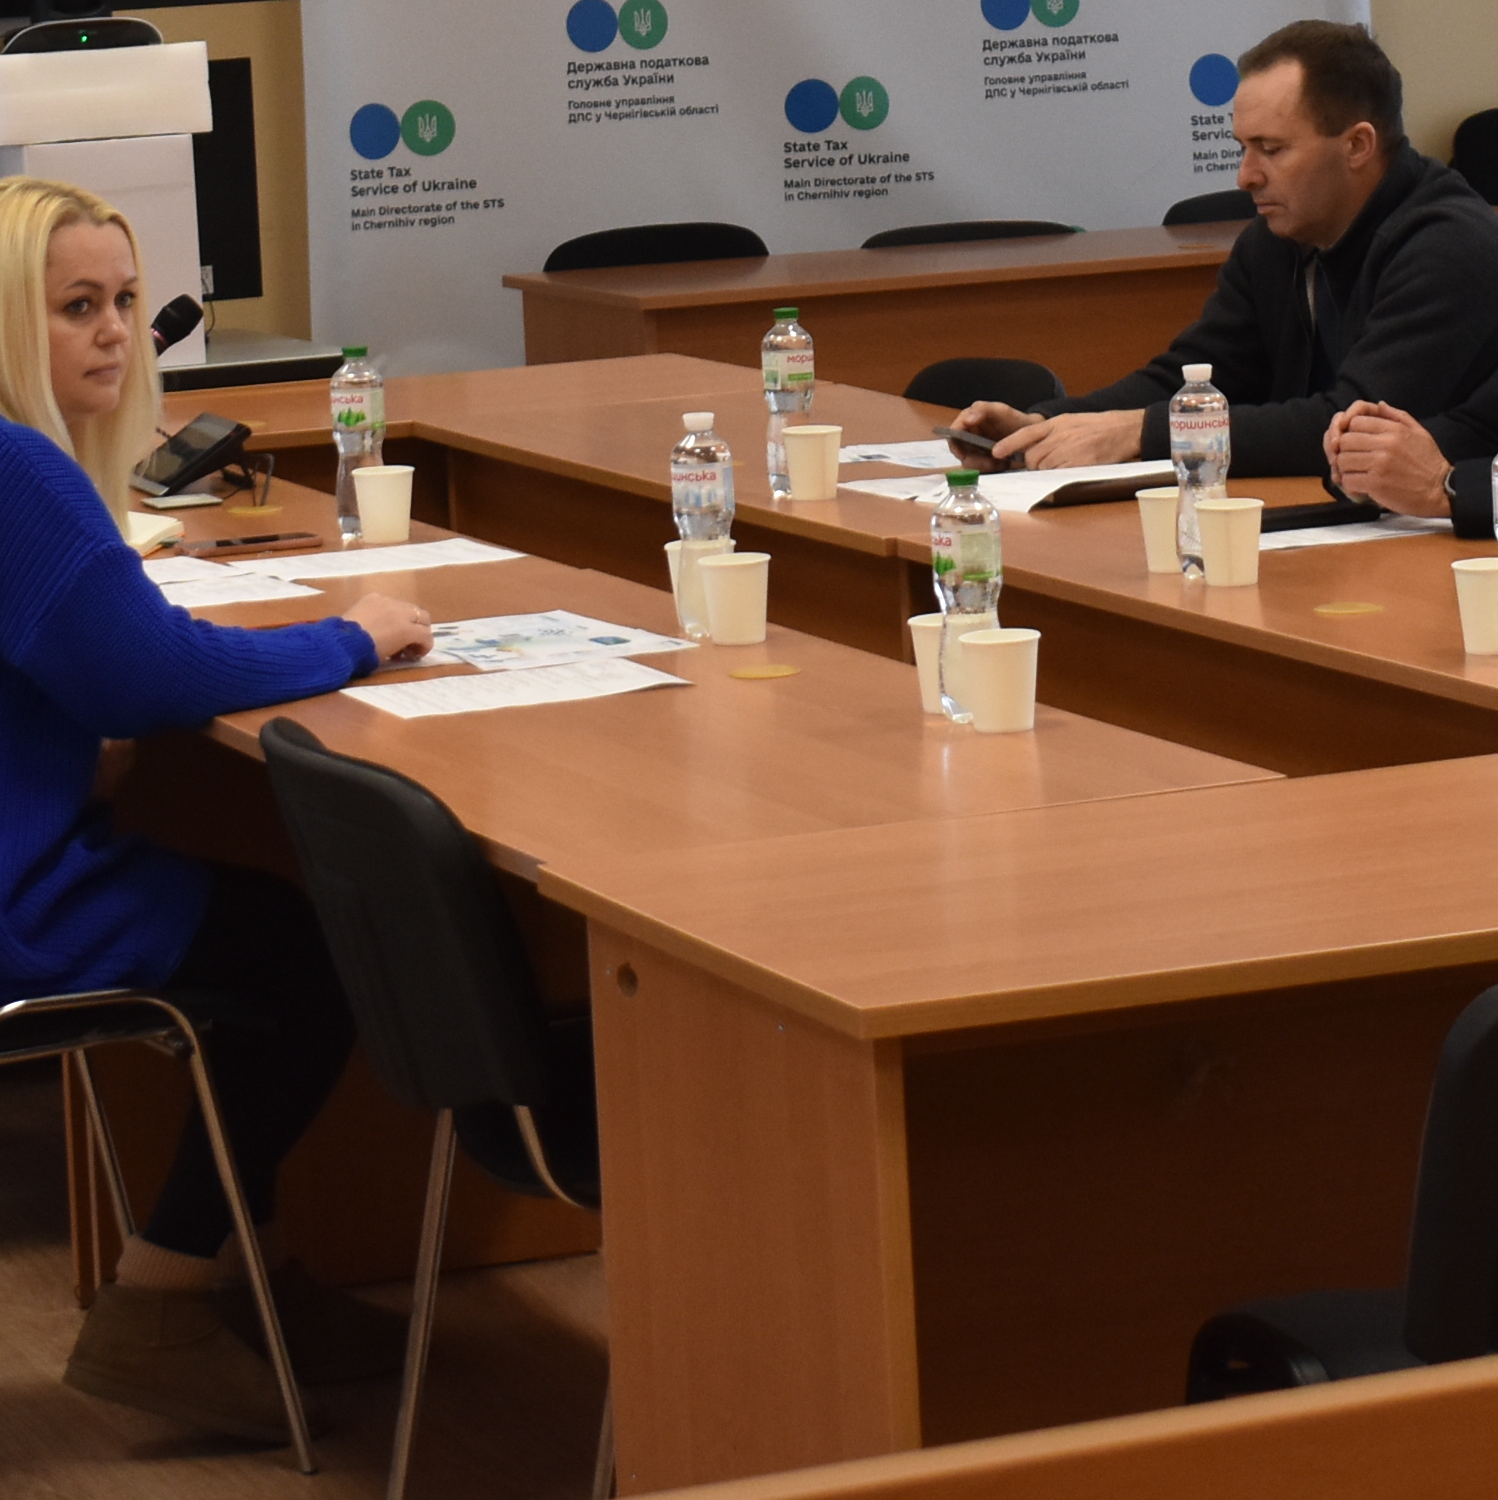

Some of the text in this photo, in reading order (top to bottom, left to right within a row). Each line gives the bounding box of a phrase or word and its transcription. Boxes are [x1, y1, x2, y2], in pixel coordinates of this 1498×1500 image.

[983, 33, 1119, 51] Державна податкова
[567, 56, 709, 75] Державна податкова
[984, 50, 1086, 67] служба України
[568, 74, 674, 90] служба України
[568, 95, 674, 110] Головне управління
[568, 104, 719, 123] ДПС у Чернігівській області
[1191, 114, 1224, 126] State
[1192, 128, 1233, 141] Servic
[784, 140, 848, 153] State Tax
[784, 152, 910, 168] Service of Ukraine
[1193, 150, 1218, 160] Main
[350, 167, 411, 181] State Tax
[1206, 161, 1242, 172] Cherni
[351, 178, 477, 197] Service of Ukraine
[352, 198, 504, 218] Main Directorate of the STS
[352, 216, 455, 231] in Chernihiv region
